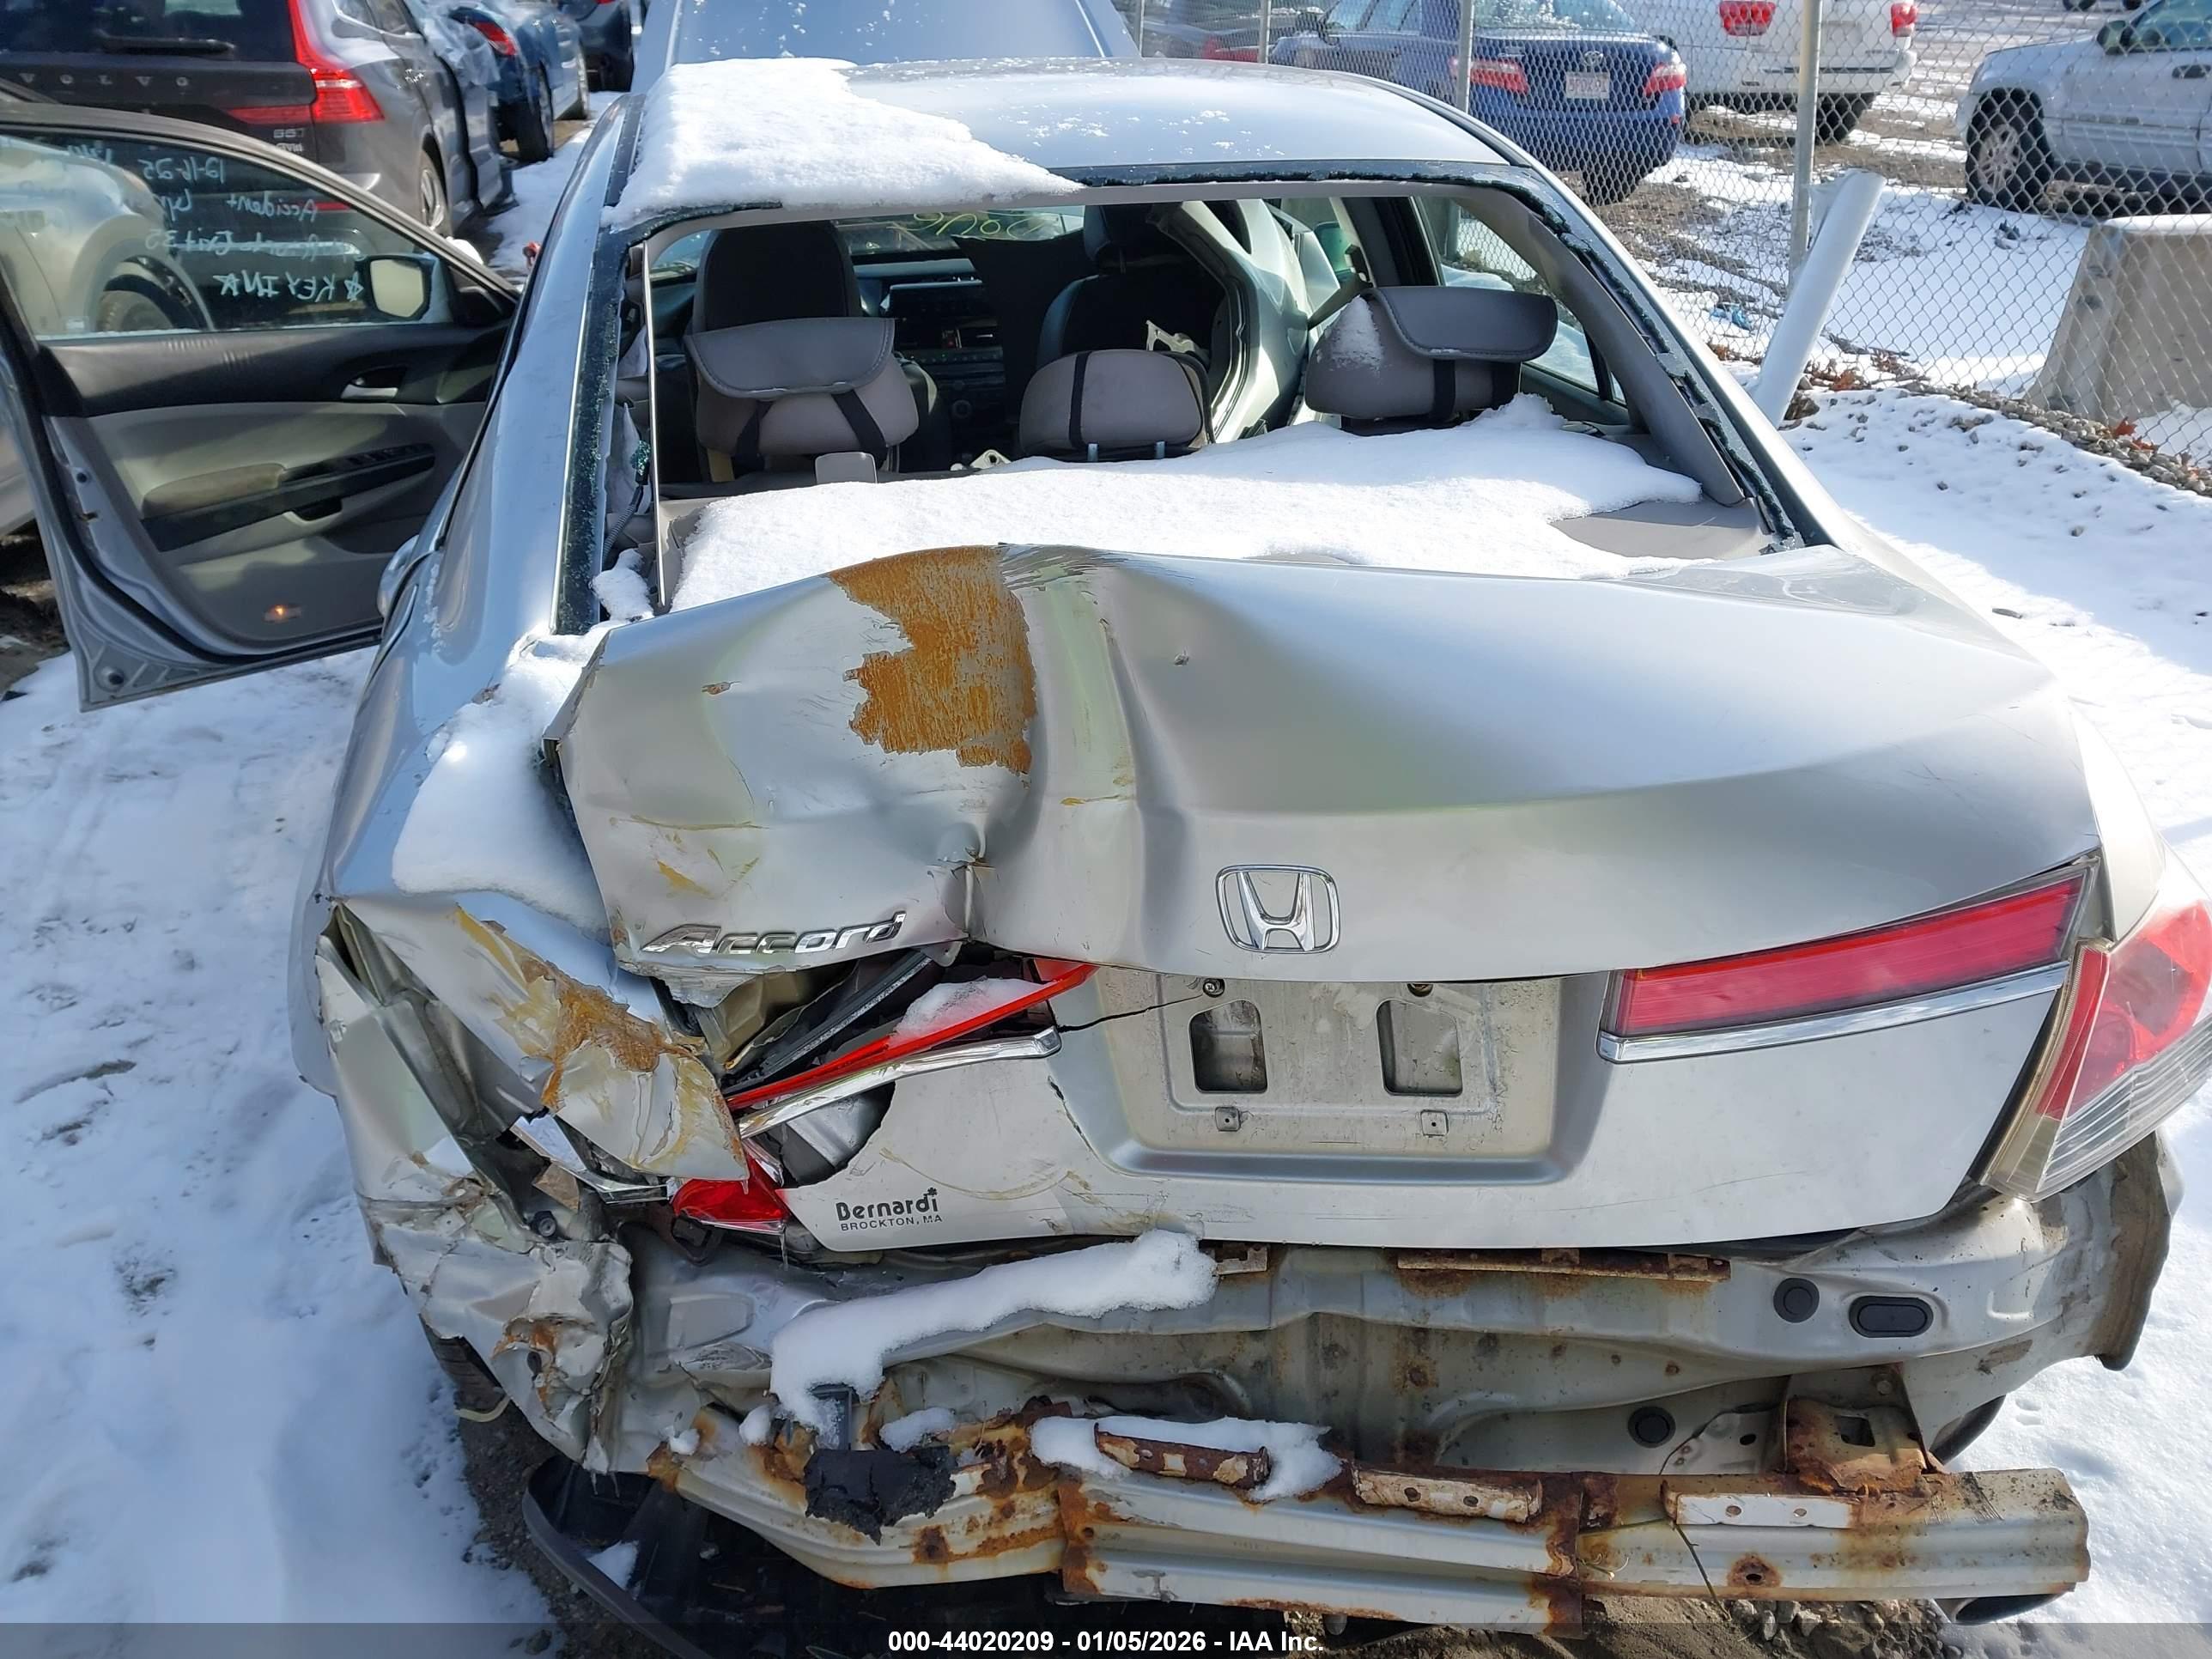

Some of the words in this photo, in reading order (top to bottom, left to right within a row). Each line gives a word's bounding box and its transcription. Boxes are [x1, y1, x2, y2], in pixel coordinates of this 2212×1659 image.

[18, 72, 190, 87] VOLVO
[640, 910, 907, 955] Accord
[836, 1188, 938, 1221] Bernardi
[841, 1216, 920, 1231] BROCKTON,
[922, 1214, 943, 1224] MA
